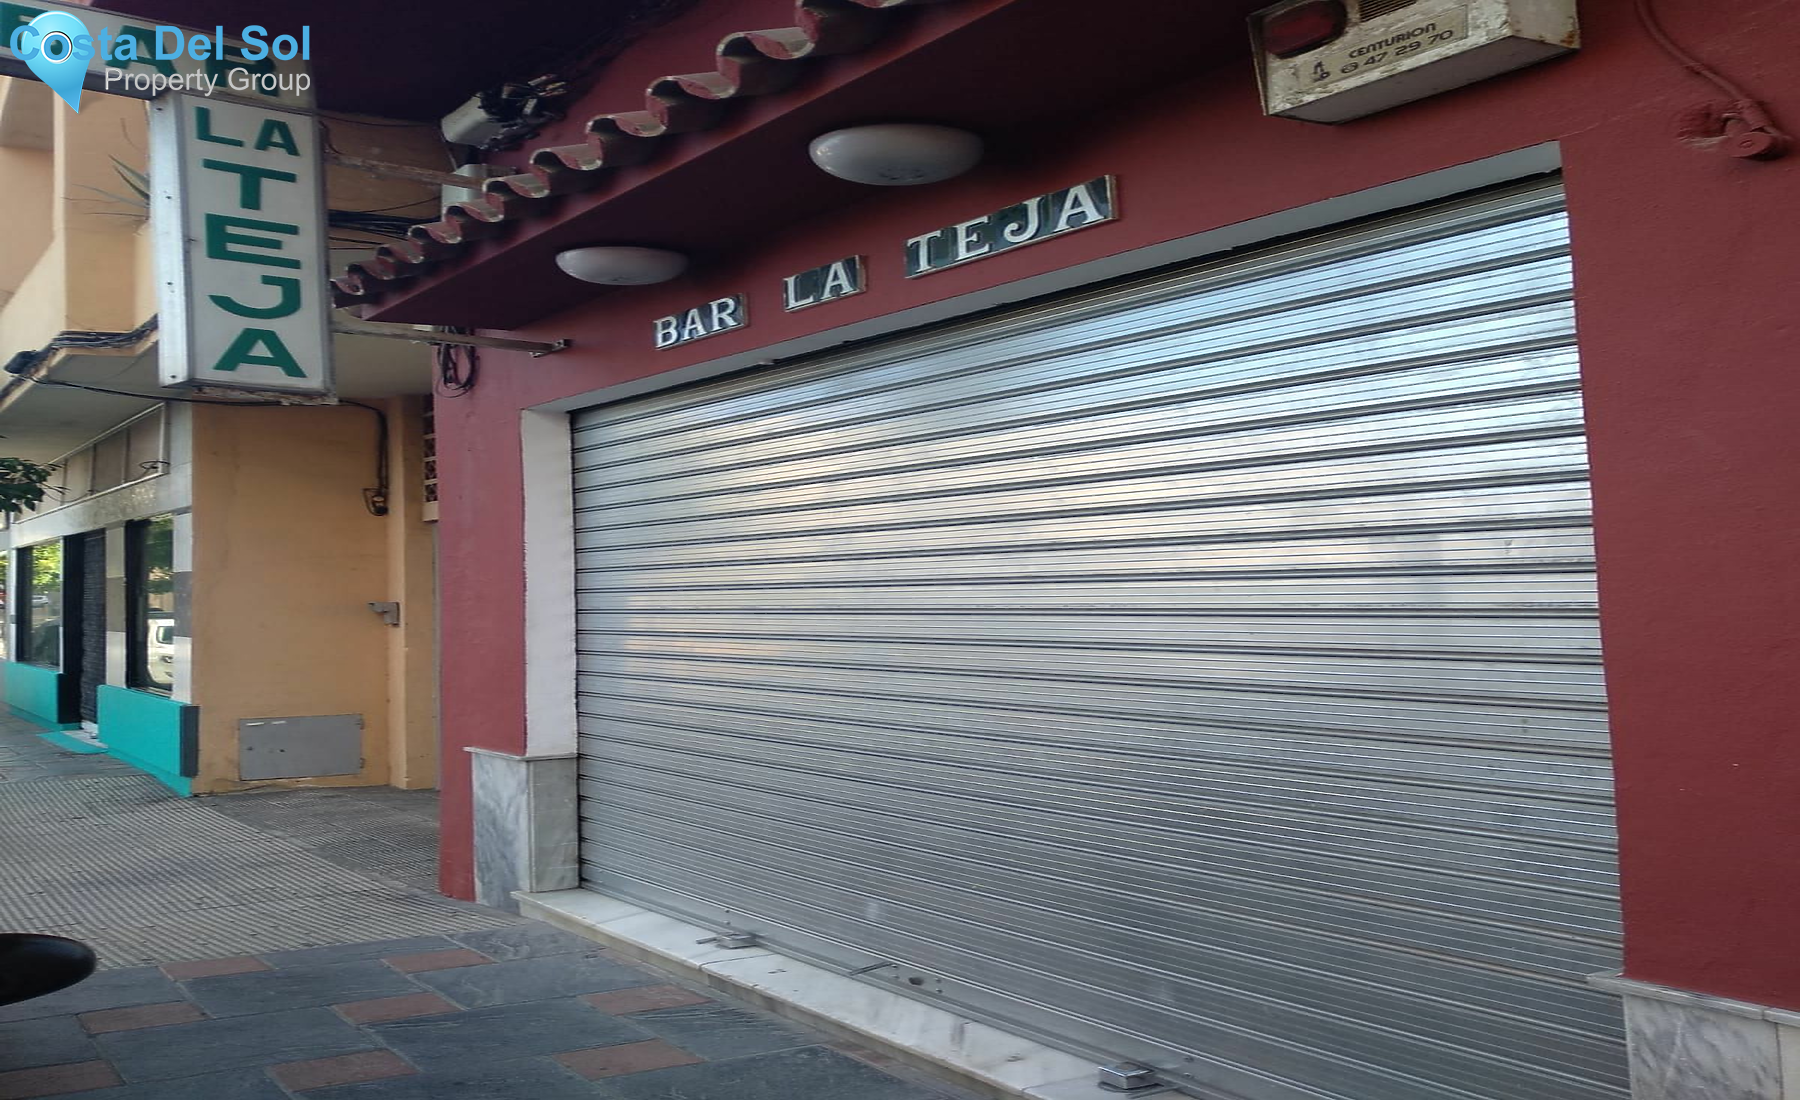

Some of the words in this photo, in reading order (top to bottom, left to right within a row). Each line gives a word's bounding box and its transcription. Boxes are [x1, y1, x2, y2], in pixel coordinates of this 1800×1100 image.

[1364, 52, 1388, 66] 47
[1395, 41, 1422, 56] 29
[1428, 30, 1454, 45] 70
[195, 106, 300, 156] LA
[202, 158, 307, 378] TEJA
[654, 296, 737, 349] BAR
[783, 262, 855, 310] LA
[906, 183, 1105, 274] TEJA
